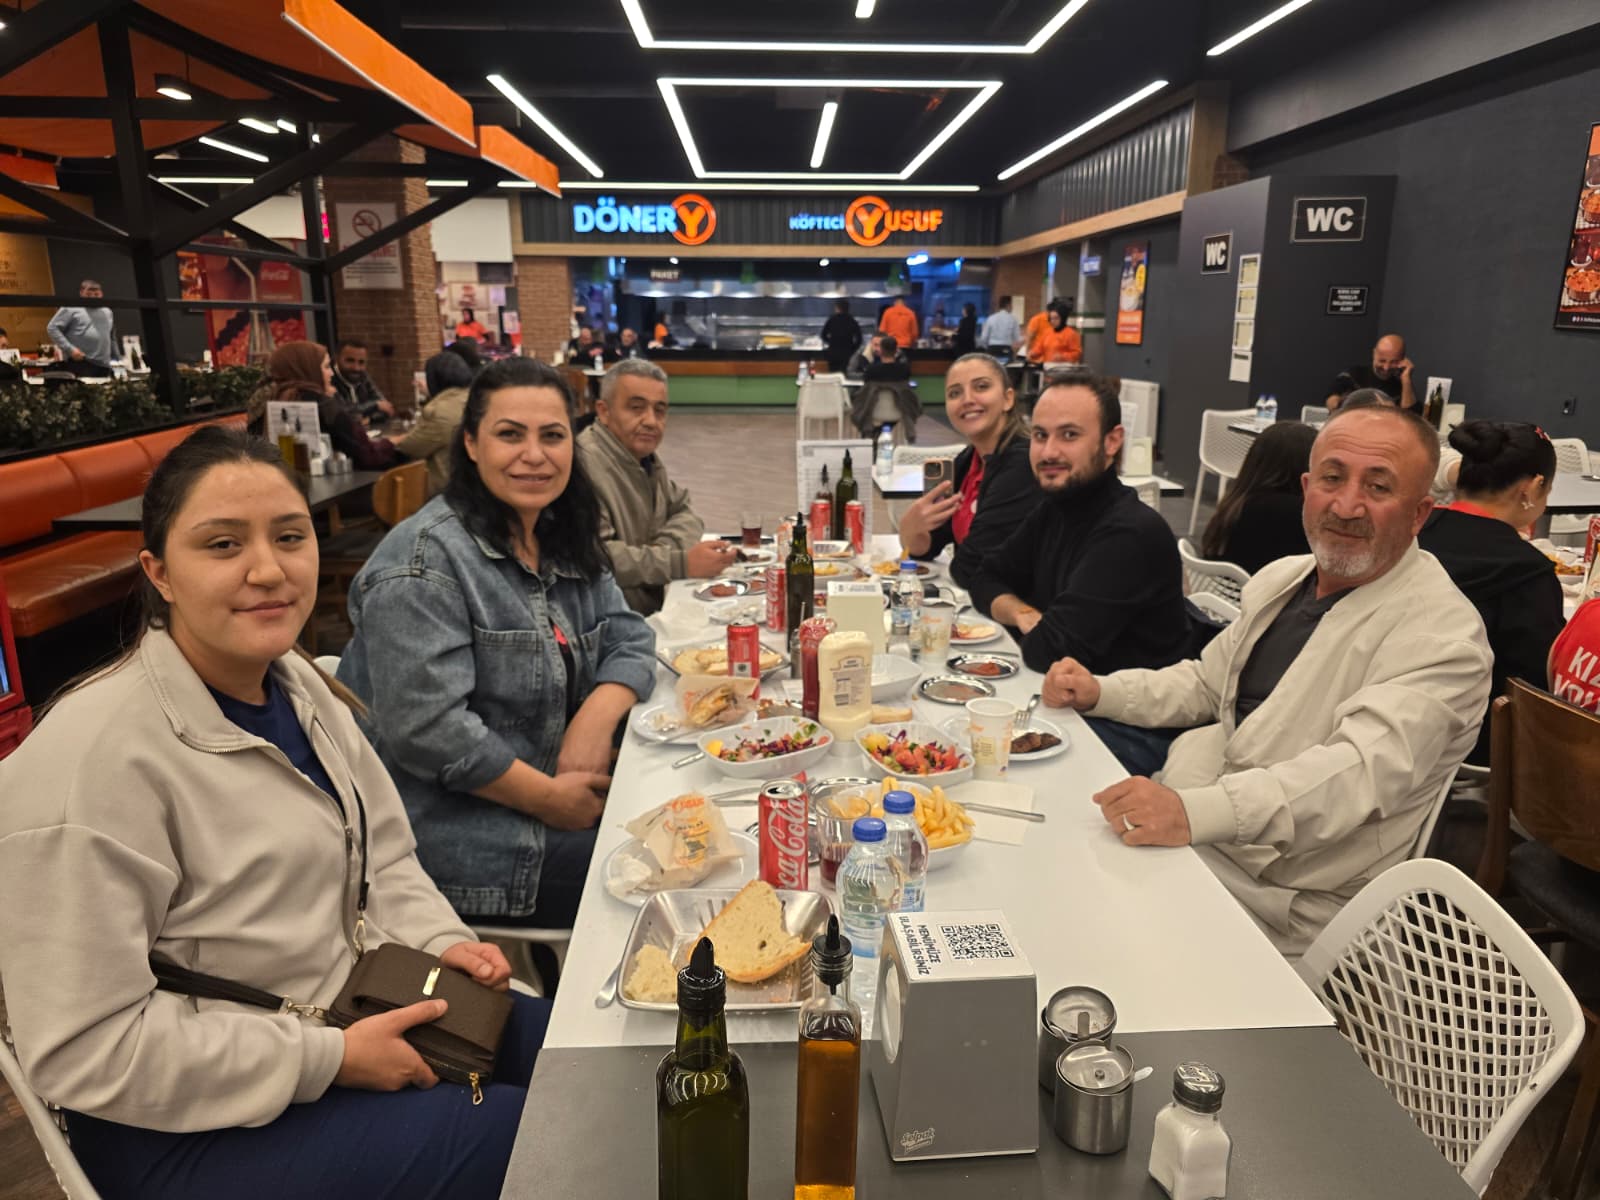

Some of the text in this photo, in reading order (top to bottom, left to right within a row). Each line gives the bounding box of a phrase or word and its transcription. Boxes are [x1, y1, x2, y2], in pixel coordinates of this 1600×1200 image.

[573, 196, 677, 233] DÖNER
[1306, 207, 1354, 233] WC
[1206, 241, 1227, 266] WC
[899, 916, 931, 976] ULAŞABİLİRSİNİZ
[917, 924, 942, 963] MENÜMÜZE
